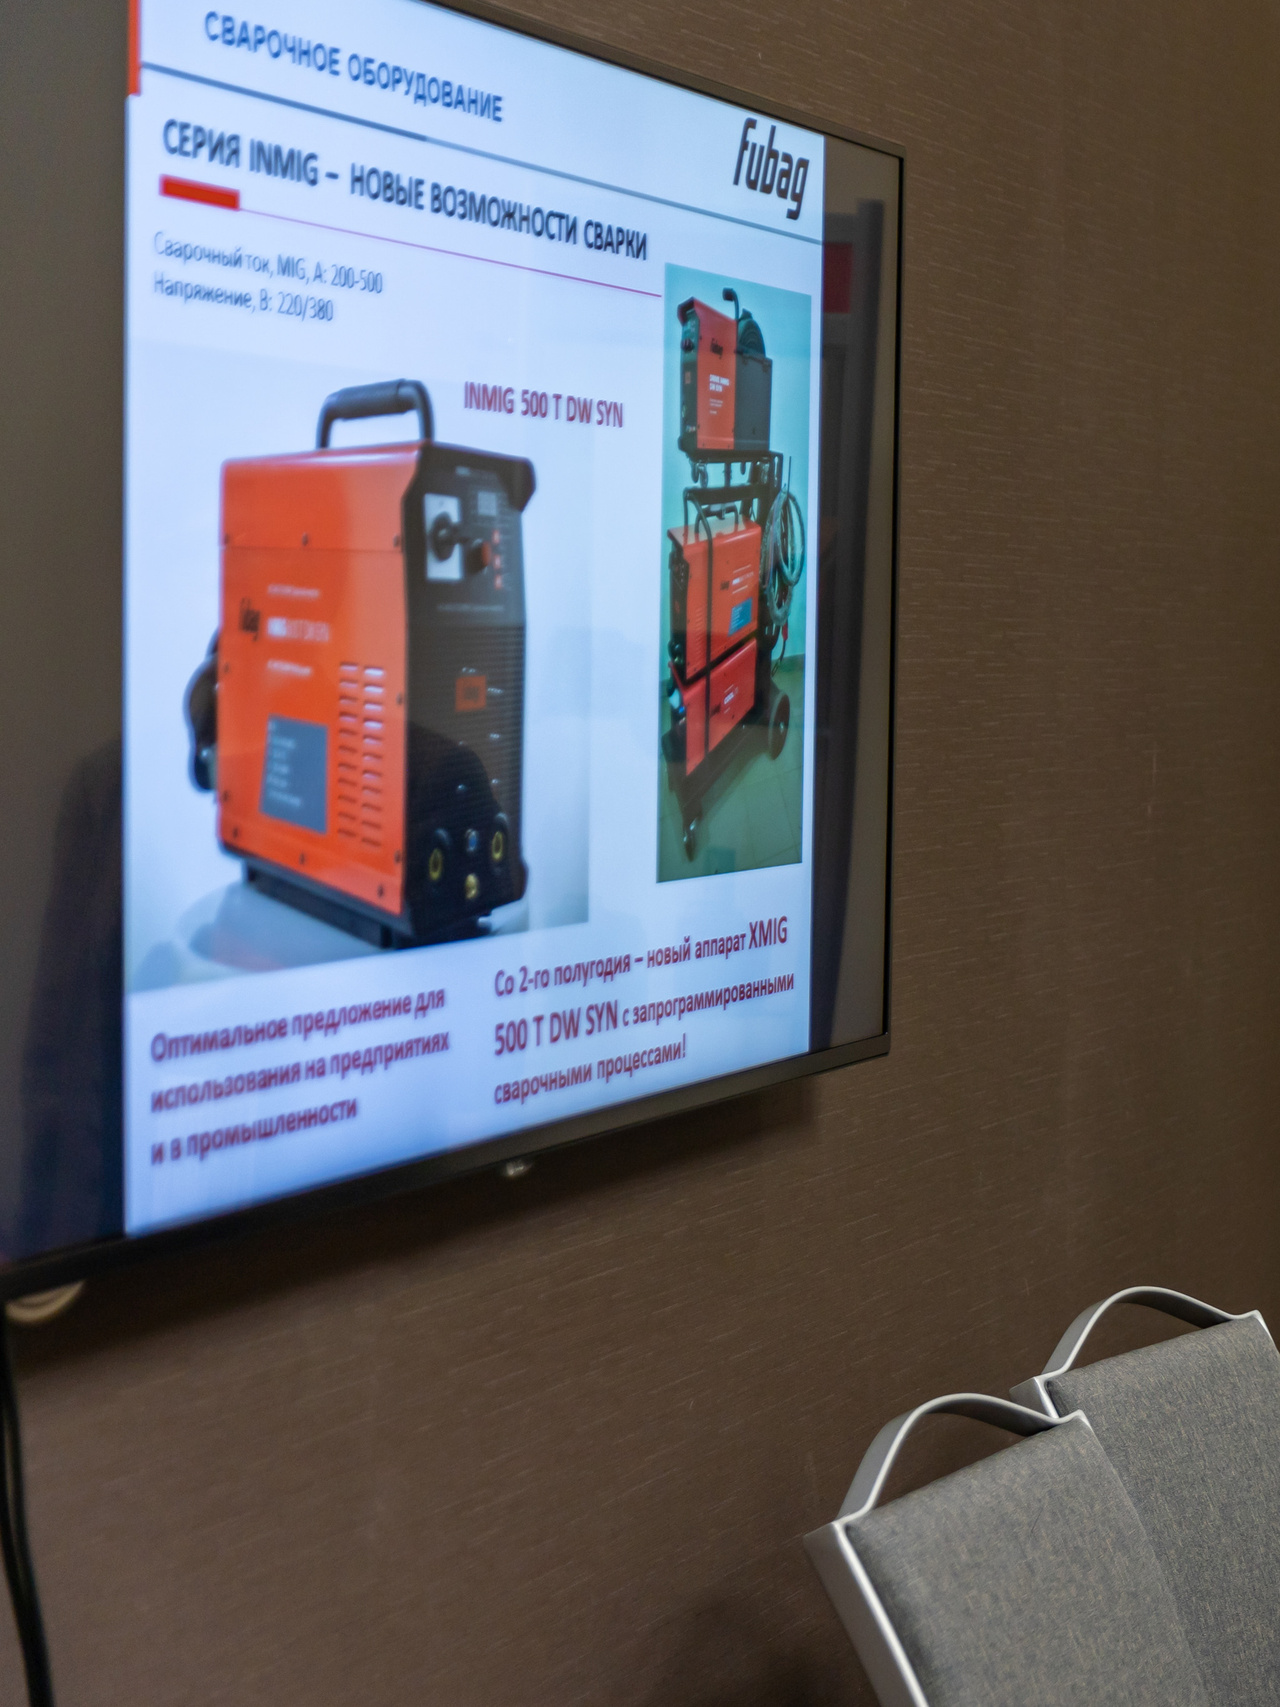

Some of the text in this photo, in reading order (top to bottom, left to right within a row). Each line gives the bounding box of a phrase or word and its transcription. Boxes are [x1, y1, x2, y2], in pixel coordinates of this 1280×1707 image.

[204, 11, 503, 122] СВАРОЧНОЕ ОБОРУДОВАНИЕ
[163, 118, 241, 168] СЕРИЯ
[250, 138, 318, 186] INMIG
[350, 162, 424, 210] НОВЫЕ
[431, 182, 577, 245] ВОЗМОЖНОСТИ
[584, 219, 648, 261] СВАРКИ
[733, 117, 810, 221] fubag
[154, 231, 242, 266] Сварочный
[277, 254, 309, 285] MIG,
[331, 263, 383, 294] 200-500
[154, 271, 255, 313] Напряжение,
[278, 291, 333, 322] 220/380
[464, 381, 514, 414] INMIG
[521, 389, 548, 418] 500
[566, 395, 593, 424] DW
[596, 400, 623, 428] SYN
[494, 969, 514, 997] Со
[519, 965, 549, 993] 2-го
[554, 953, 630, 987] полугодия
[647, 935, 691, 968] новый
[695, 932, 746, 959] аппарат
[748, 916, 788, 949] XMIG
[151, 988, 445, 1062] Оптимальное предложение для
[495, 1018, 527, 1056] 500
[550, 1007, 581, 1043] DW
[586, 1000, 618, 1035] SYN
[632, 973, 794, 1025] запрограммированными
[152, 1031, 449, 1113] использования на предприятиях
[494, 1032, 686, 1105] сварочными процессами!
[152, 1098, 357, 1165] и в промышленности
